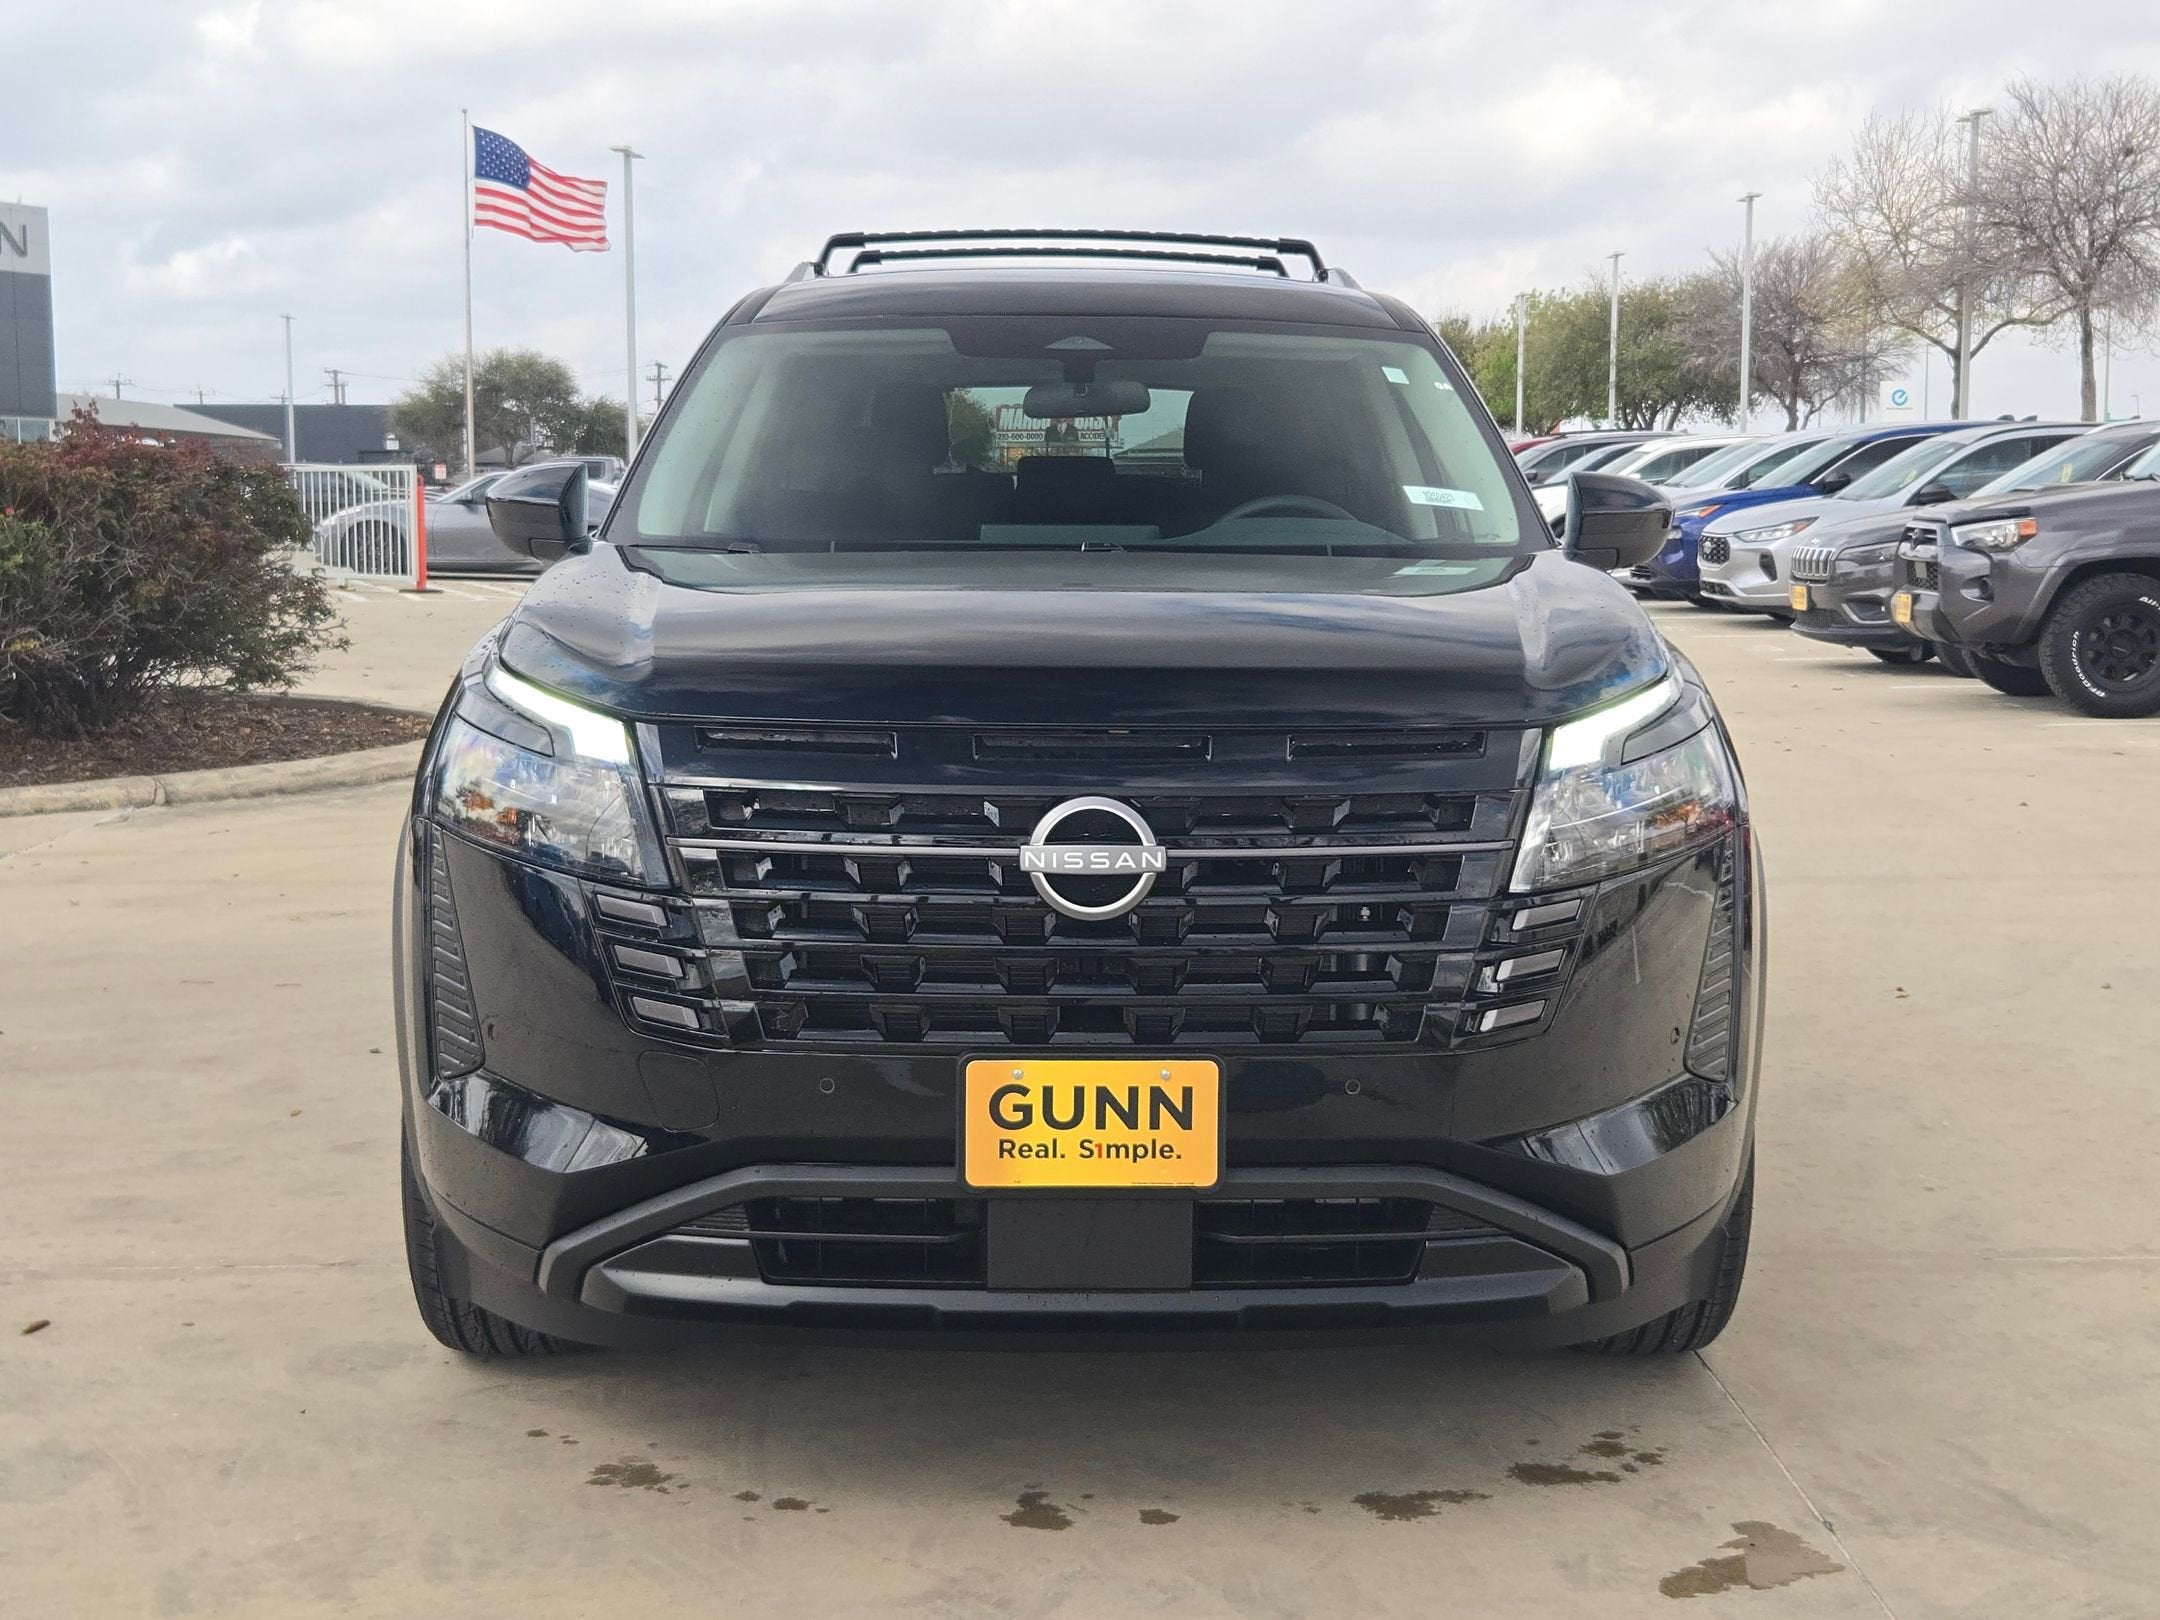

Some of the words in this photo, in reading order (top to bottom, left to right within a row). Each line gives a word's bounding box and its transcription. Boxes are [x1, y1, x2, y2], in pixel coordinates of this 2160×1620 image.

[1024, 850, 1163, 869] NISSAN
[988, 1083, 1193, 1131] GUNN
[998, 1138, 1066, 1160] Real.
